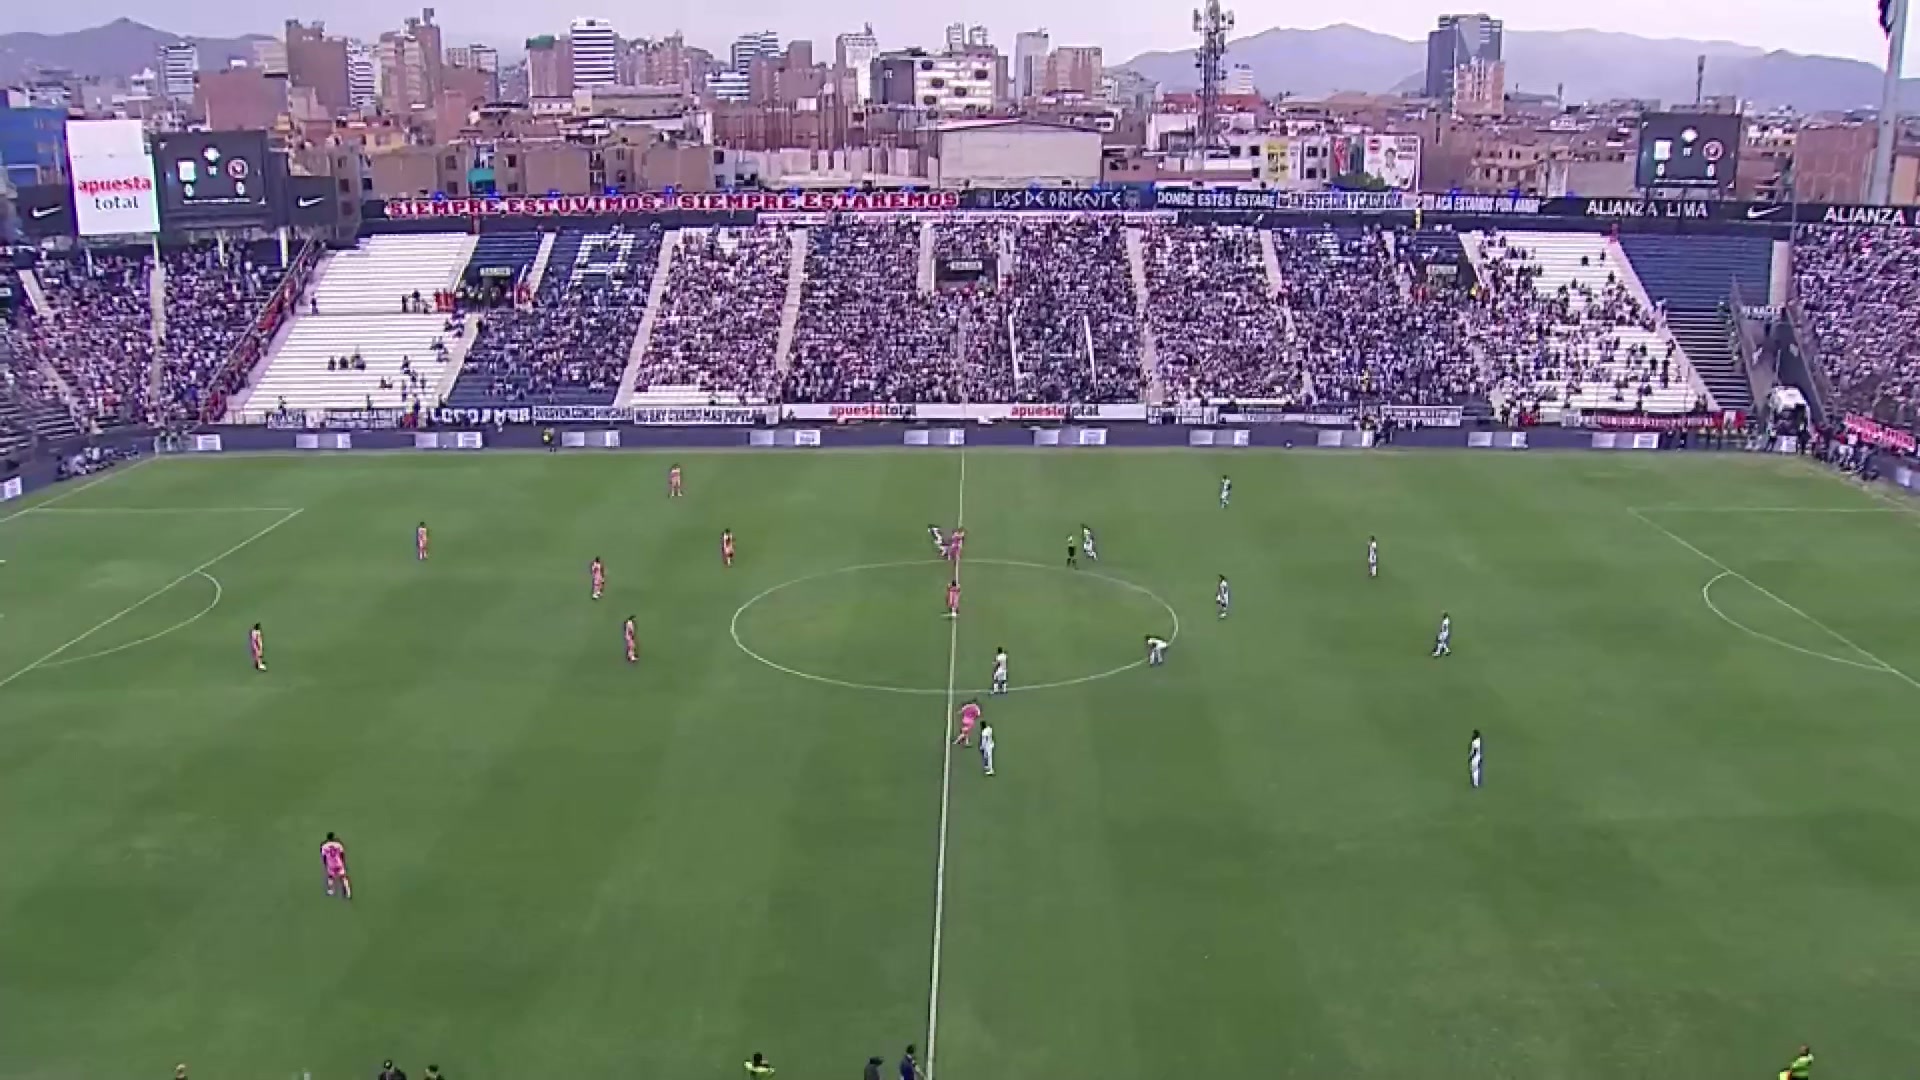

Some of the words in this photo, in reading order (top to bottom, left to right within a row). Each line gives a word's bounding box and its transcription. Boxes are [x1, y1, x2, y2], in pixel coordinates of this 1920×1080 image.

[78, 177, 152, 196] apuesta
[95, 196, 140, 210] total
[390, 199, 500, 216] SIEMPRE
[507, 195, 656, 214] ESTUVIMOS
[681, 194, 796, 209] SIEMPRE
[803, 192, 958, 209] ESTAREMOS
[993, 190, 1022, 208] LOS
[1025, 190, 1046, 207] DE
[1049, 190, 1122, 208] ORIENTE
[1157, 191, 1195, 206] DONDE
[1586, 199, 1658, 217] ALIANZA
[1666, 201, 1709, 217] LIMA
[1824, 205, 1905, 225] ALIANZA
